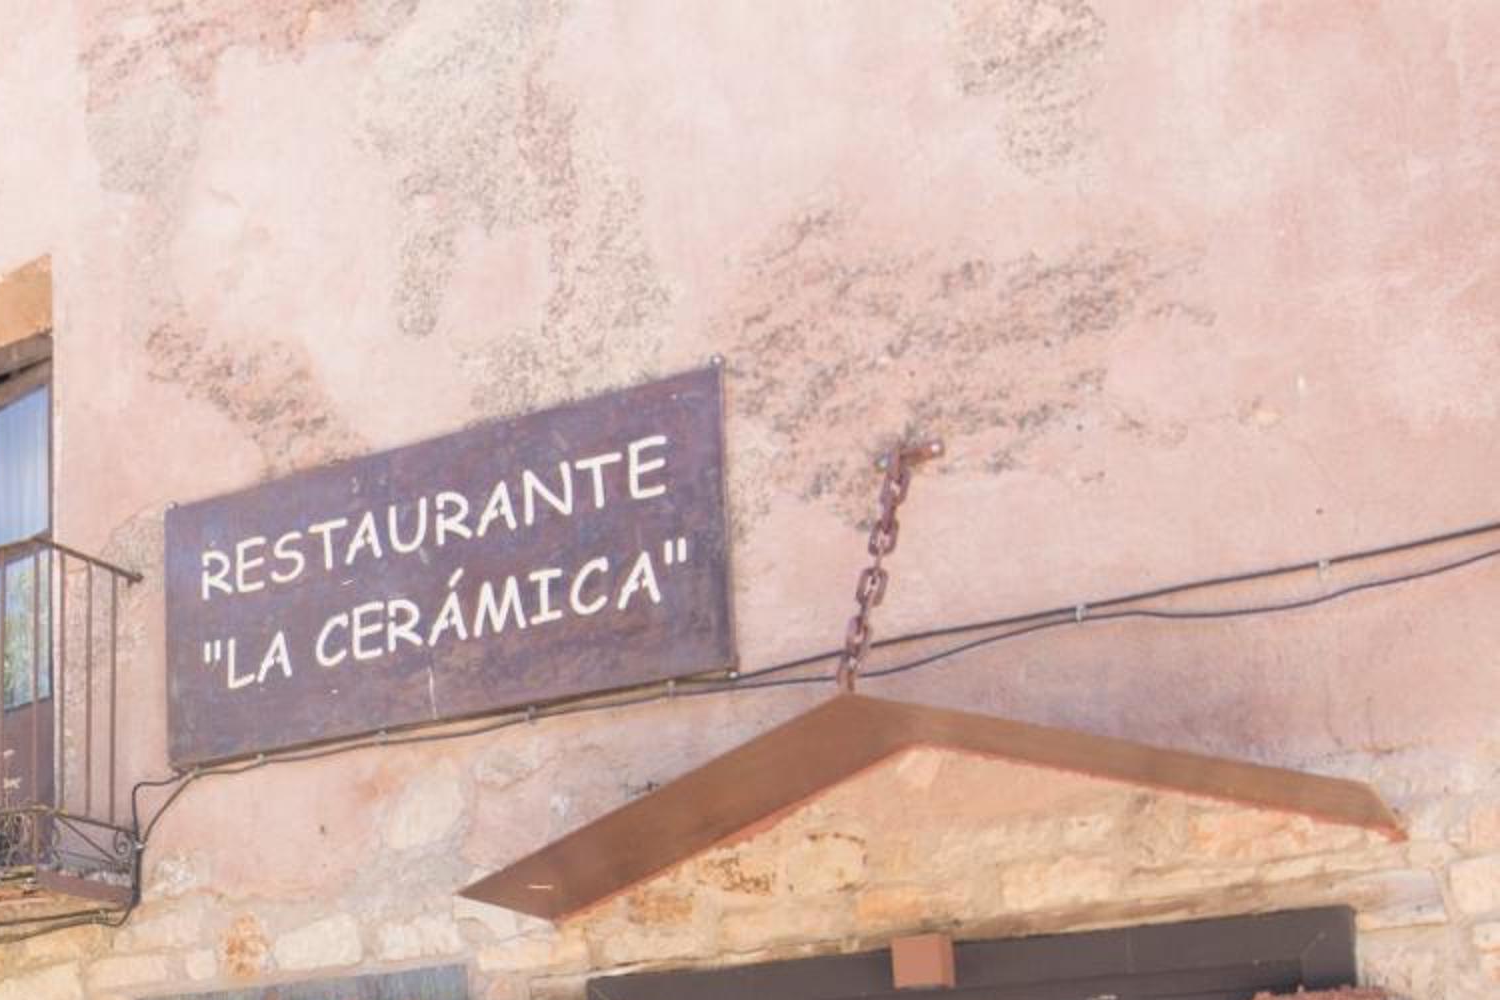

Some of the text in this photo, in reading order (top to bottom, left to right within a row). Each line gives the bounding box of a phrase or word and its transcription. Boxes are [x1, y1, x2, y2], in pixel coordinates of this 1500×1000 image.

[200, 434, 668, 600] RESTAURANTE
[203, 537, 687, 689] "LA CERÁMICA"
